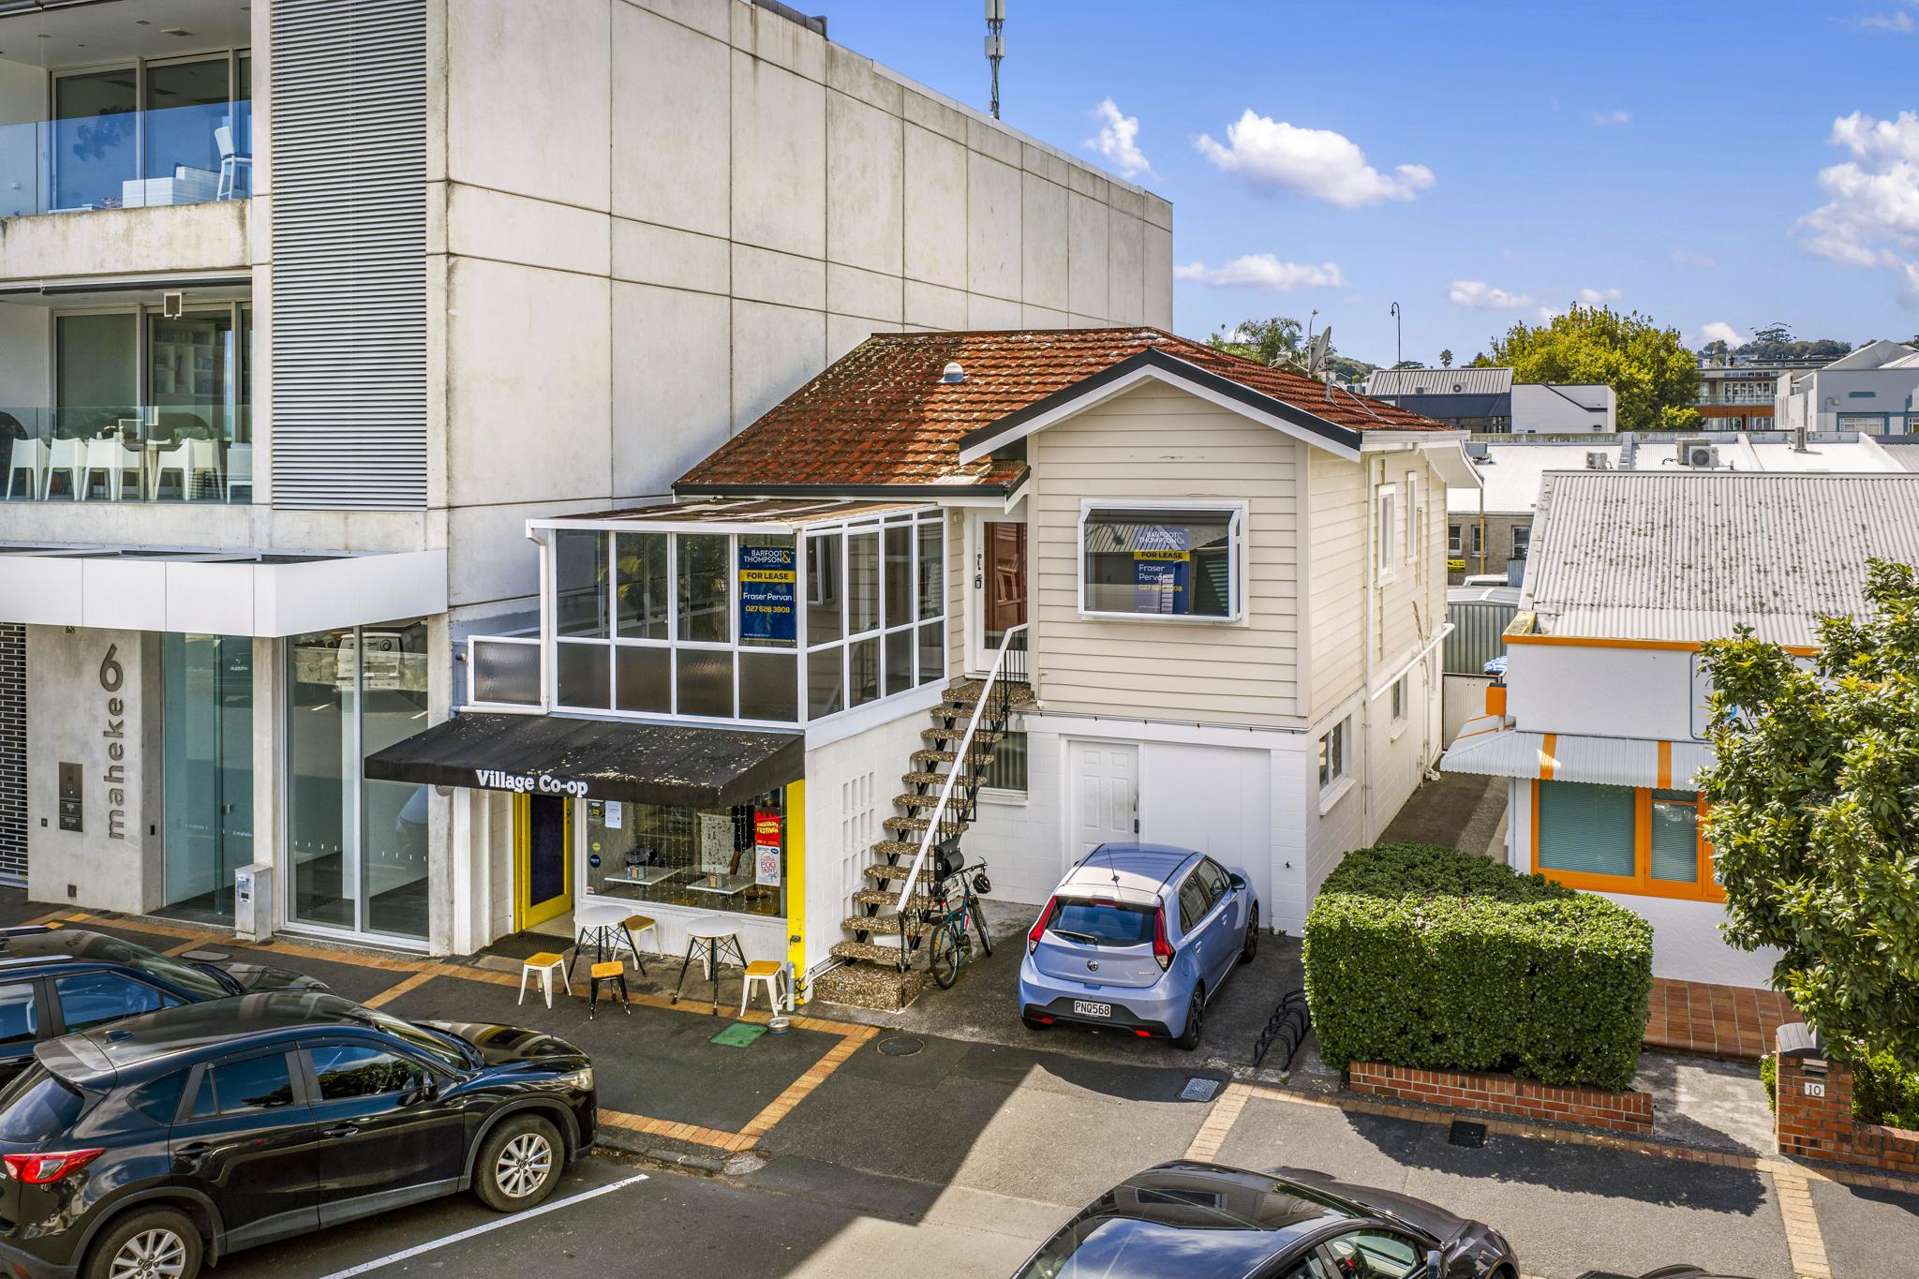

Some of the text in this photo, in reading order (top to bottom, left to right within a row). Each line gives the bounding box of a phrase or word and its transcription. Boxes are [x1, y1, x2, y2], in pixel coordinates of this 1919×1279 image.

[783, 551, 791, 563] &
[1159, 551, 1183, 559] LEASE
[1138, 563, 1165, 572] Fraser
[746, 571, 789, 580] FOR LEASE
[743, 592, 792, 601] Fraser Pervan
[99, 642, 124, 693] 6
[475, 768, 589, 799] Village Co-op
[1075, 1002, 1110, 1016] PNQ568
[1808, 1084, 1821, 1095] 10
